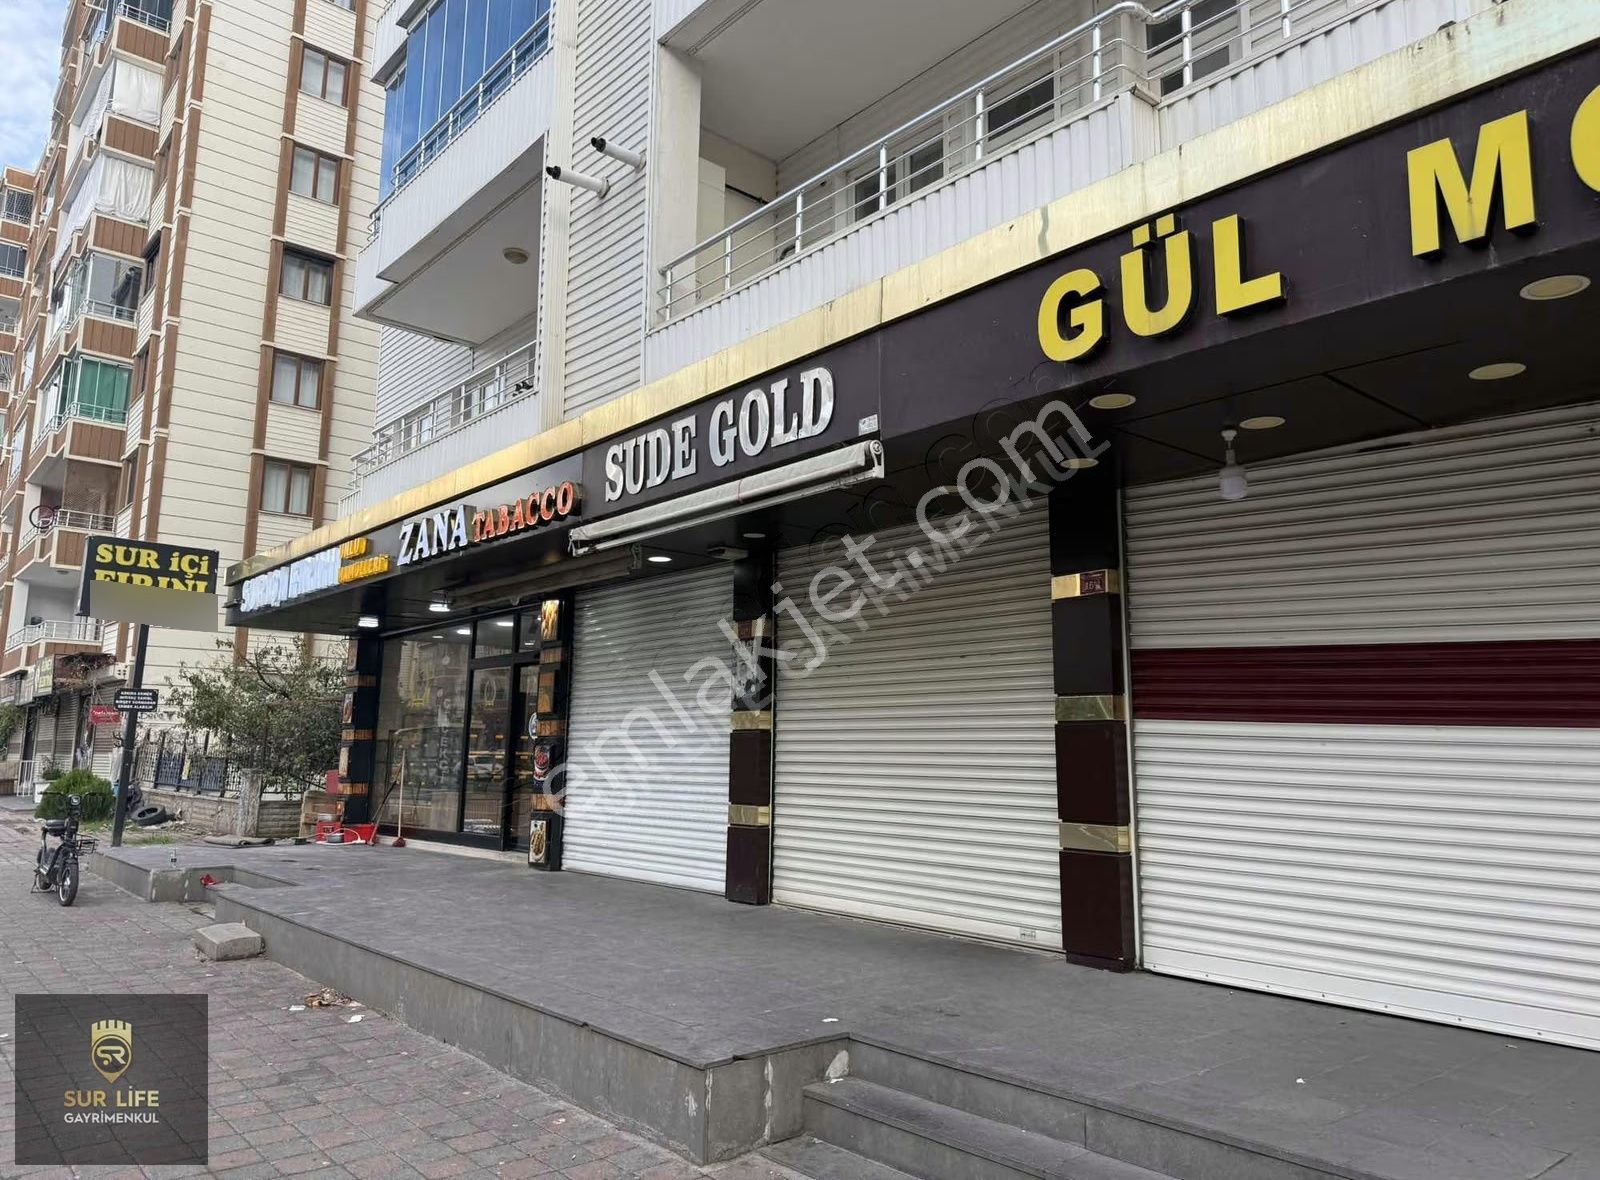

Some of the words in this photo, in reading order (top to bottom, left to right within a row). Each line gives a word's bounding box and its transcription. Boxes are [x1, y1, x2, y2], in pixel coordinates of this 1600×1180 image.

[1038, 213, 1283, 363] GÜL
[1406, 83, 1600, 257] M
[605, 415, 698, 502] SUDE
[708, 367, 835, 467] GOLD
[96, 543, 160, 569] SUR
[397, 504, 469, 566] ZANA
[472, 480, 576, 543] TABACCO
